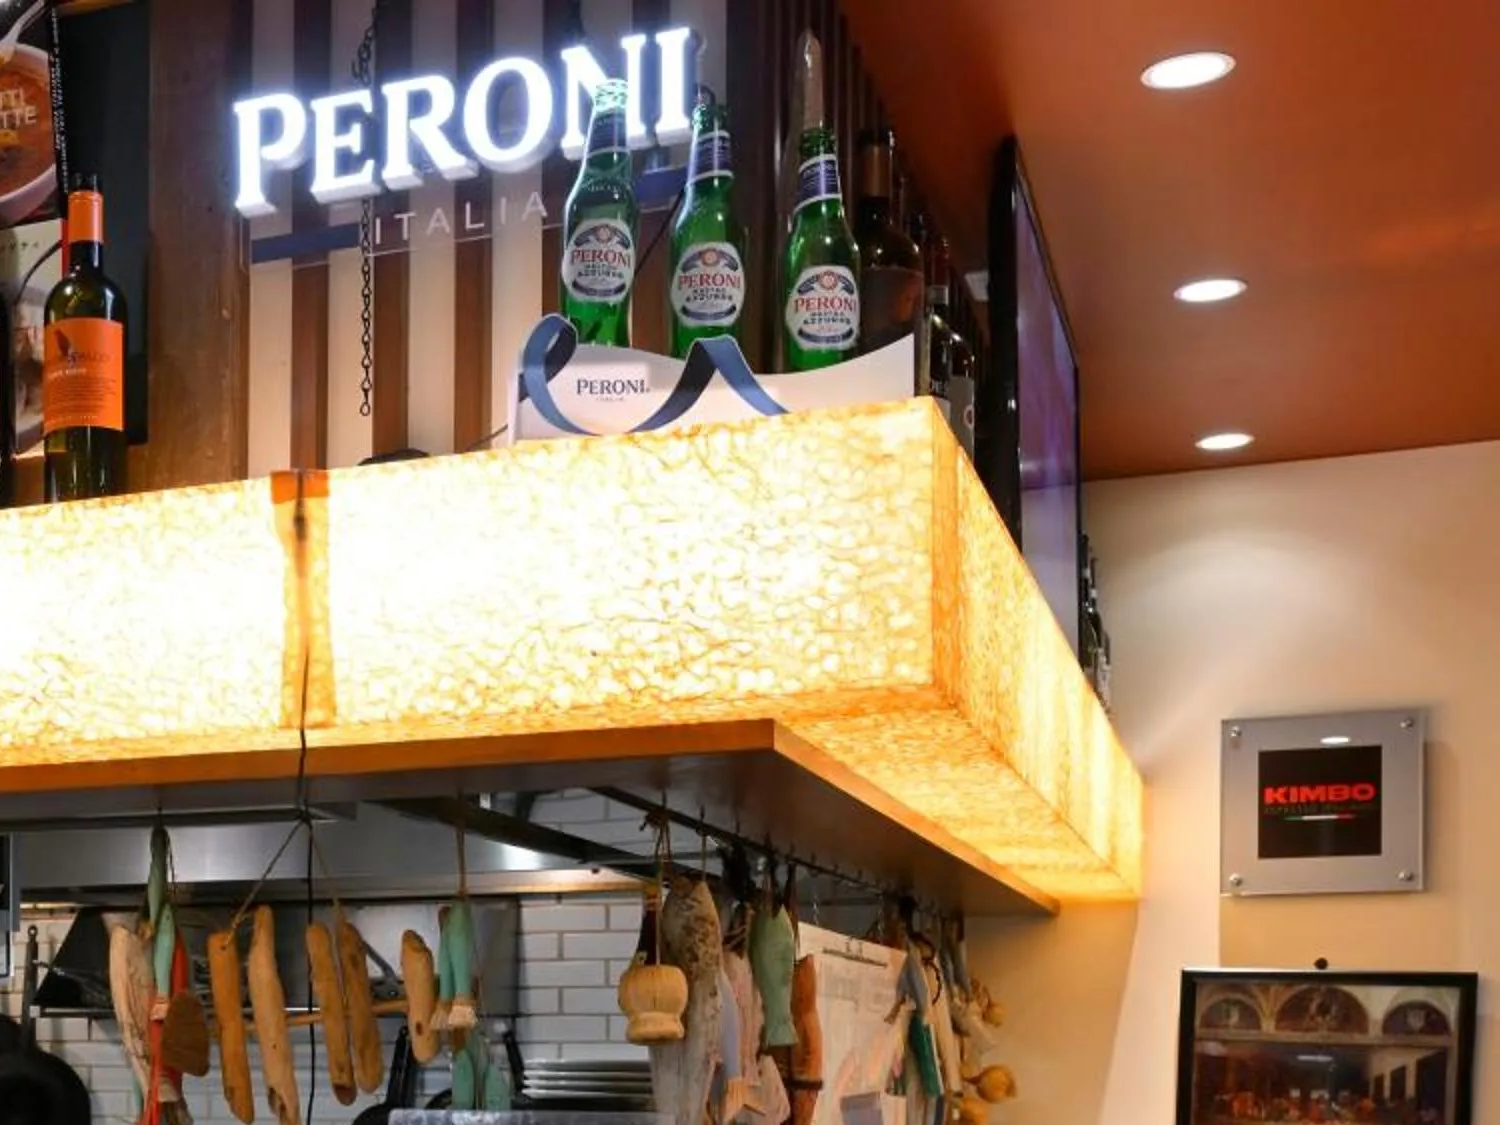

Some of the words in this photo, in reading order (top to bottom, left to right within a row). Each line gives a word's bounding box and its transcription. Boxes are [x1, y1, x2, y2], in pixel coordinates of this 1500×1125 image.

[233, 26, 693, 218] PERONI
[373, 191, 548, 246] ITALIA
[571, 246, 632, 269] PERONI
[678, 273, 741, 292] PERONI
[793, 295, 858, 313] PERONI
[576, 377, 646, 396] PERONI
[1263, 783, 1377, 805] KIMBO
